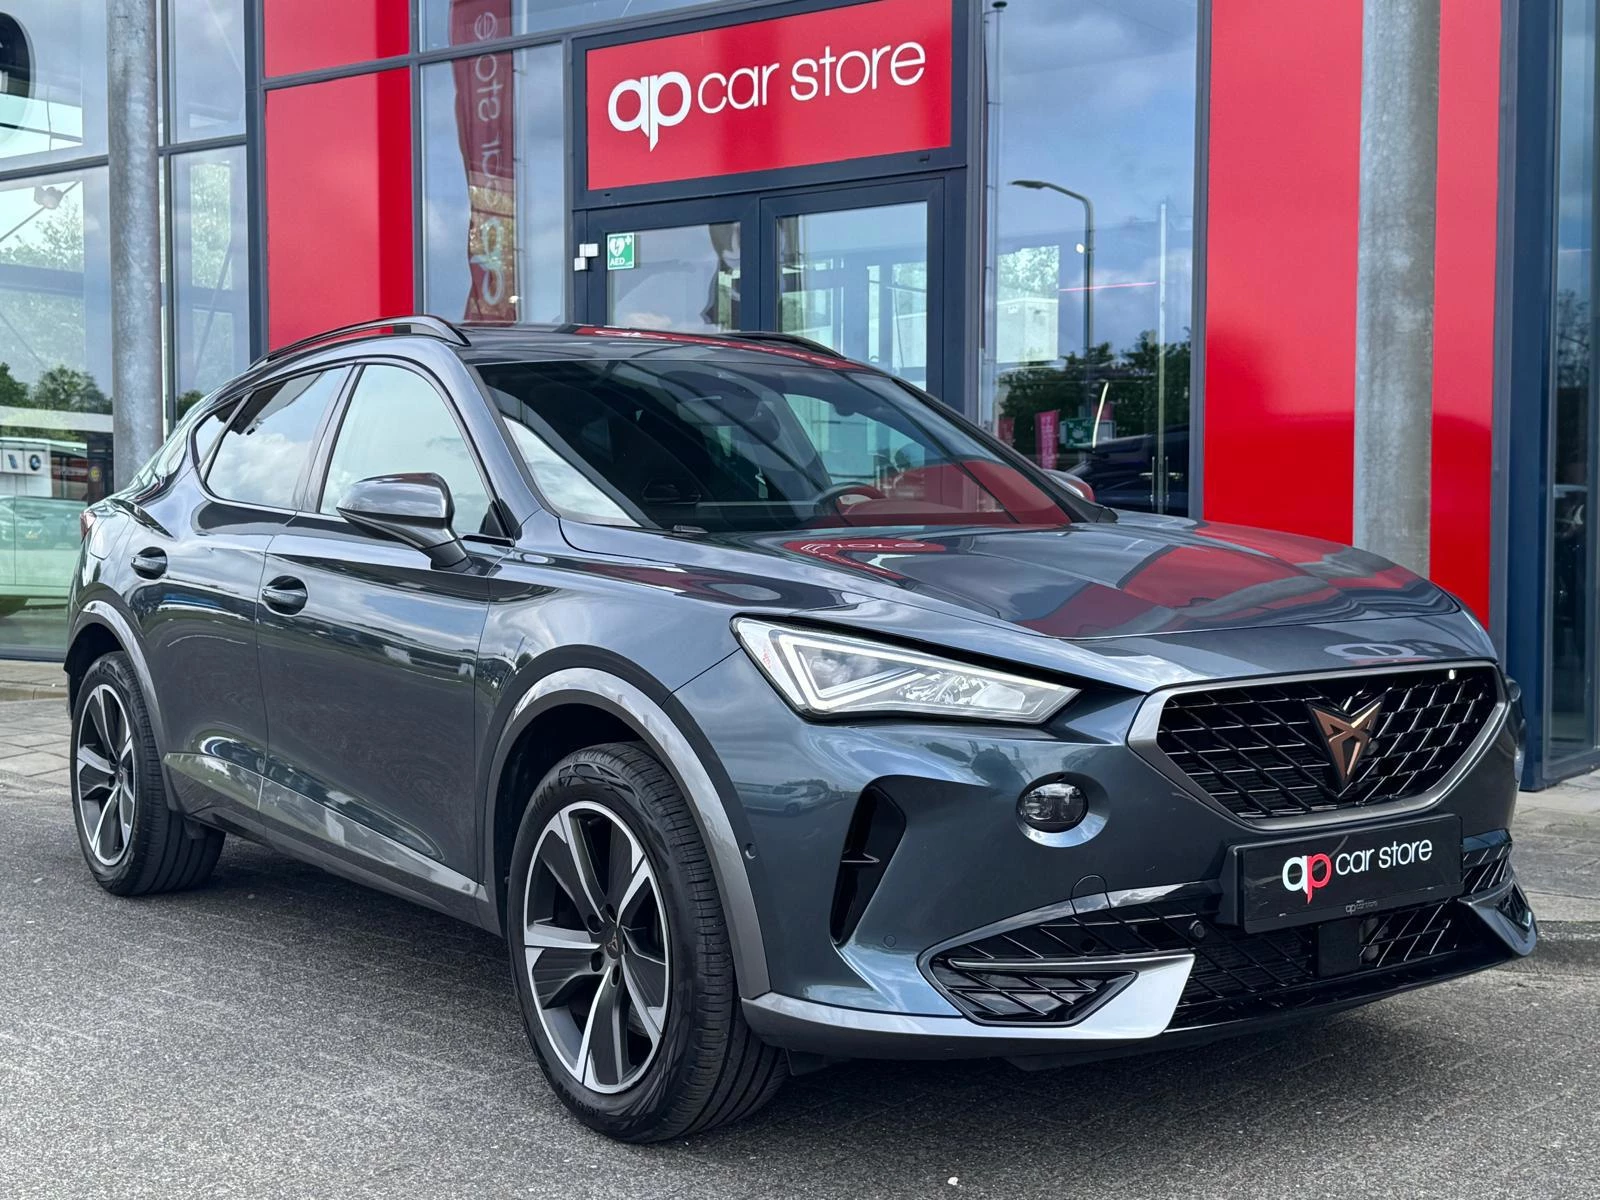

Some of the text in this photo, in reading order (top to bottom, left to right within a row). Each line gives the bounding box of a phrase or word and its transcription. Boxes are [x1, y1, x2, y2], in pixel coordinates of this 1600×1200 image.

[608, 42, 926, 152] ap car store
[609, 257, 626, 266] AED
[1282, 839, 1432, 904] ap car store
